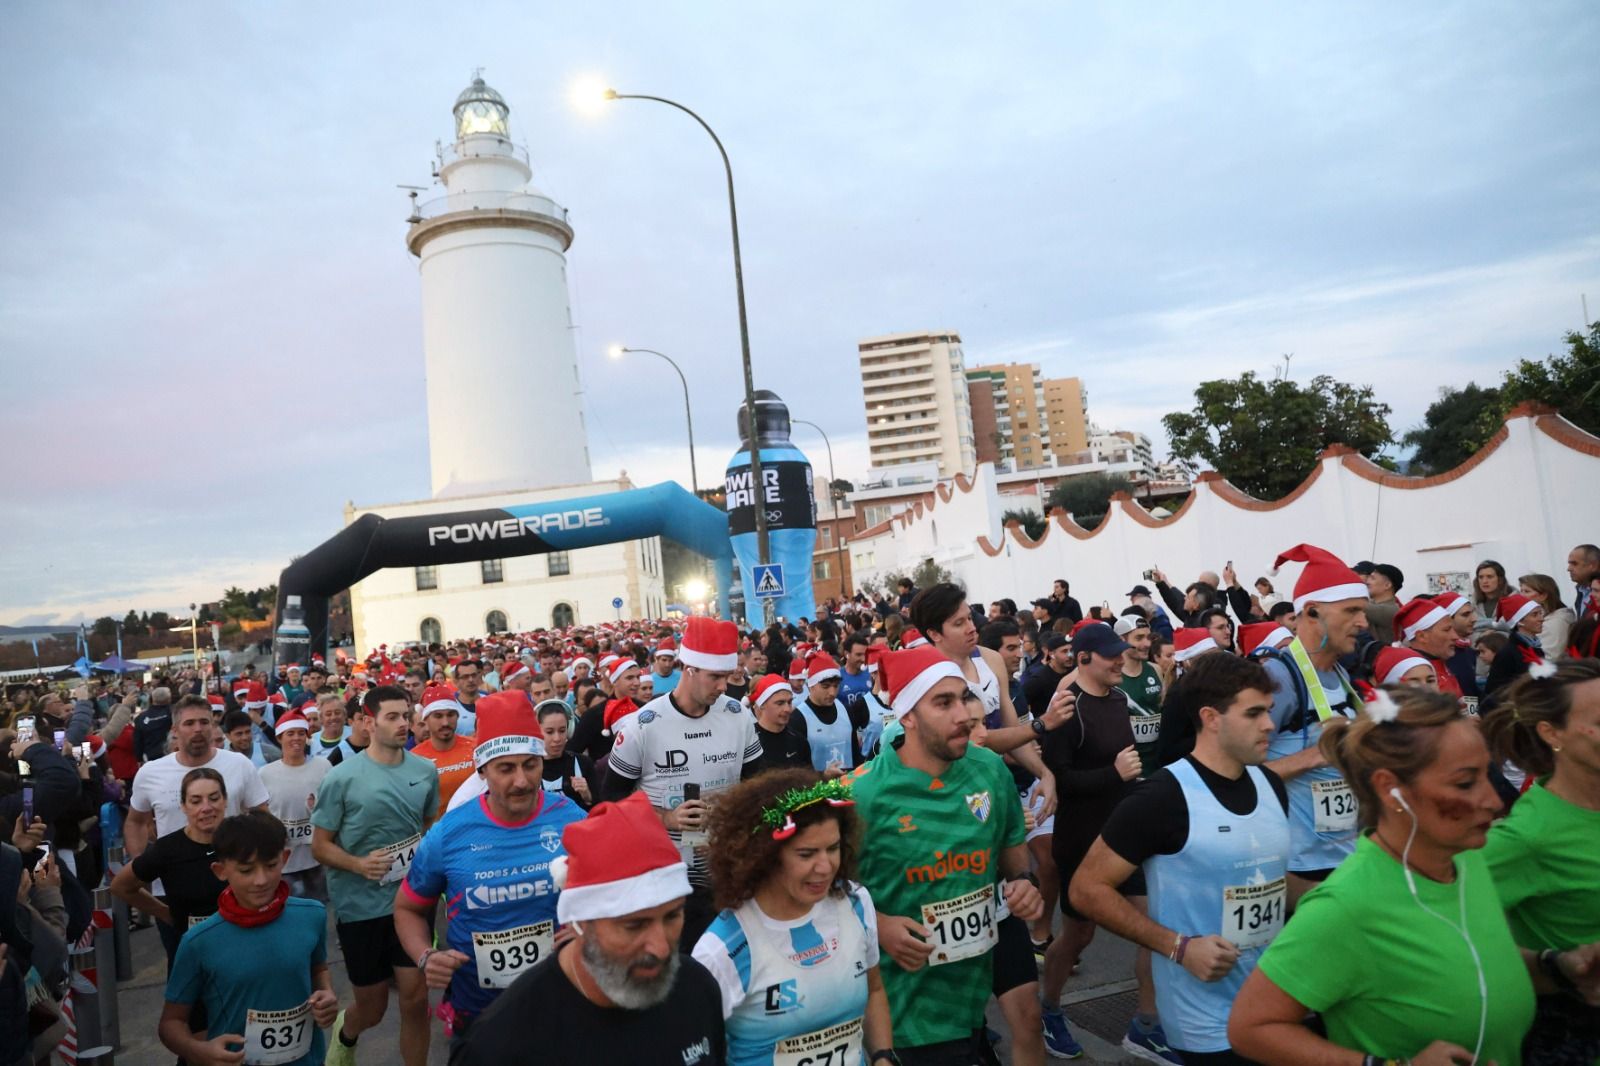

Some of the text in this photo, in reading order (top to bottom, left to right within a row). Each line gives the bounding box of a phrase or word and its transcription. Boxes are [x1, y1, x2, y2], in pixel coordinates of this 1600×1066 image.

[428, 507, 604, 546] POWERADE
[502, 736, 529, 744] NAVIDAD
[684, 729, 712, 740] luanvi
[654, 749, 689, 768] JD
[511, 867, 519, 876] A
[521, 862, 550, 873] CORR
[947, 898, 962, 908] SAN
[1233, 896, 1281, 930] 1341
[494, 931, 511, 939] SAN
[512, 921, 552, 935] SILVESTRE
[934, 904, 991, 945] 1094
[490, 941, 539, 971] 939
[261, 1019, 306, 1049] 637
[785, 1039, 799, 1047] VII
[802, 1033, 822, 1044] SAN
